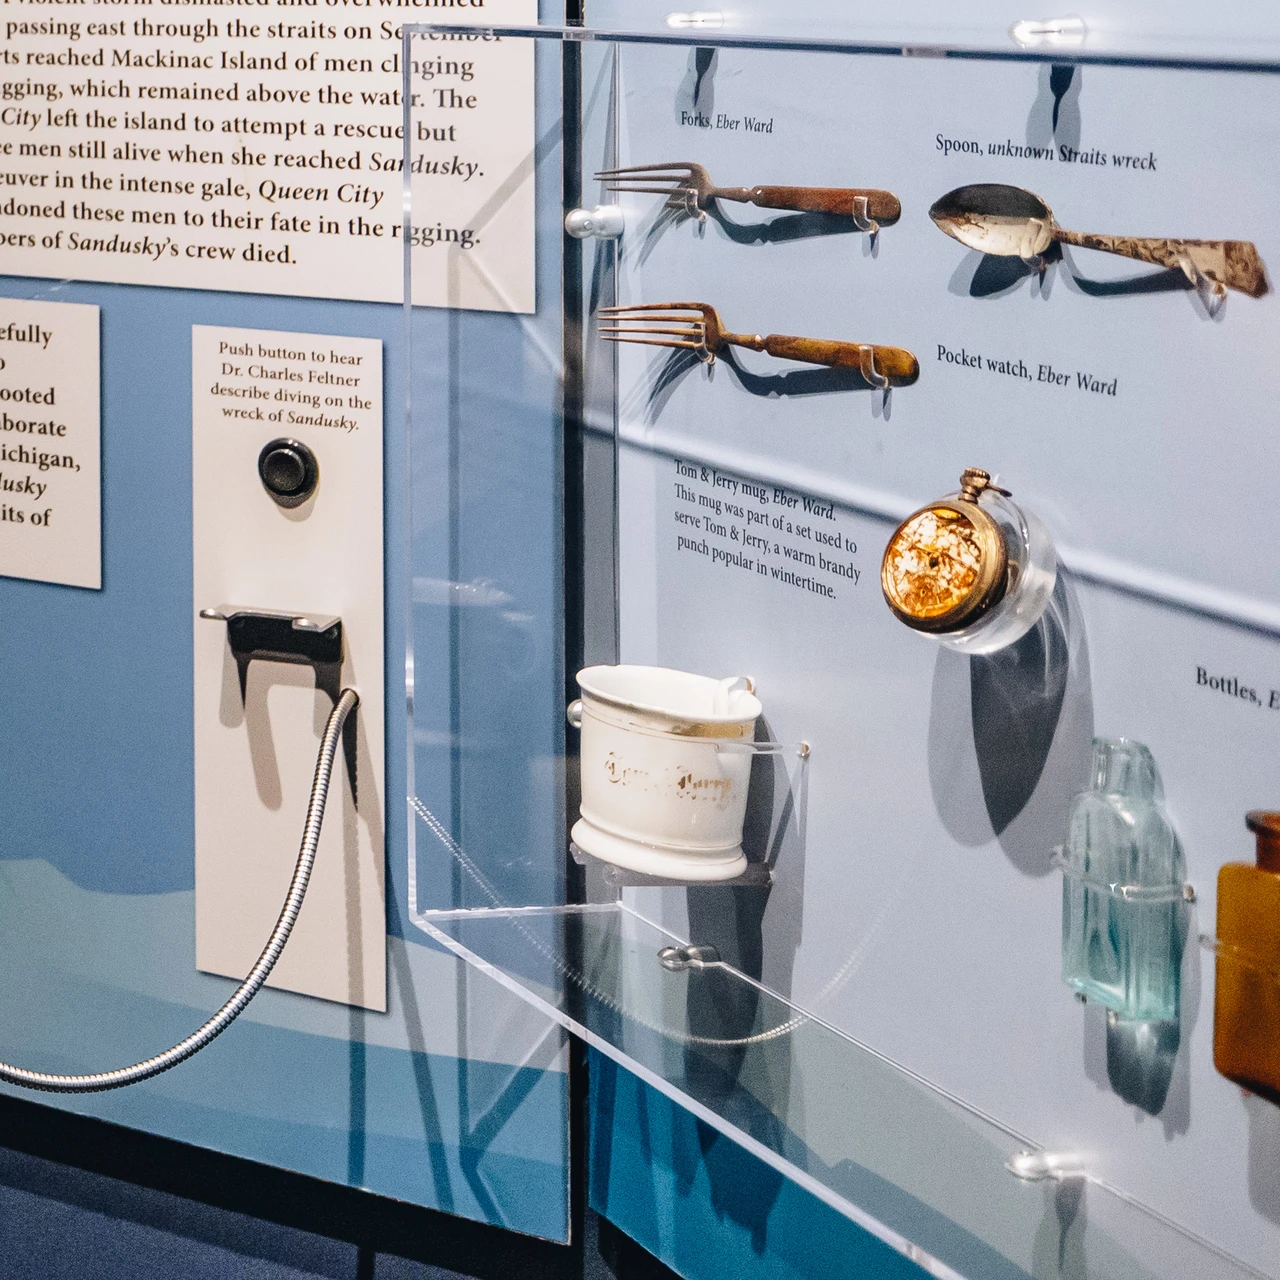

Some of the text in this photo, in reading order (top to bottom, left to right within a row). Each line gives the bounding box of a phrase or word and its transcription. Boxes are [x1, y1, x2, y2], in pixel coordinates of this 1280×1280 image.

[716, 113, 741, 131] Eber
[743, 116, 774, 135] Ward
[935, 133, 1158, 172] Spoon, unknown Straits wreck
[219, 341, 364, 366] Push button to hear
[936, 343, 1118, 397] Pocket watch, Eber Ward
[221, 362, 361, 387] Dr. Charles Feltner
[210, 381, 372, 410] describe diving on the
[221, 406, 360, 434] wreck of Sandusky.
[673, 458, 837, 522] Tom & Jerry mug, Eber Ward.
[29, 508, 53, 527] of
[673, 482, 858, 554] This mug was part of a set used to
[674, 510, 862, 587] serve Tom & Jerry, a warm brandy
[677, 535, 837, 600] punch popular in wintertime.
[1196, 665, 1263, 709] Bottles,
